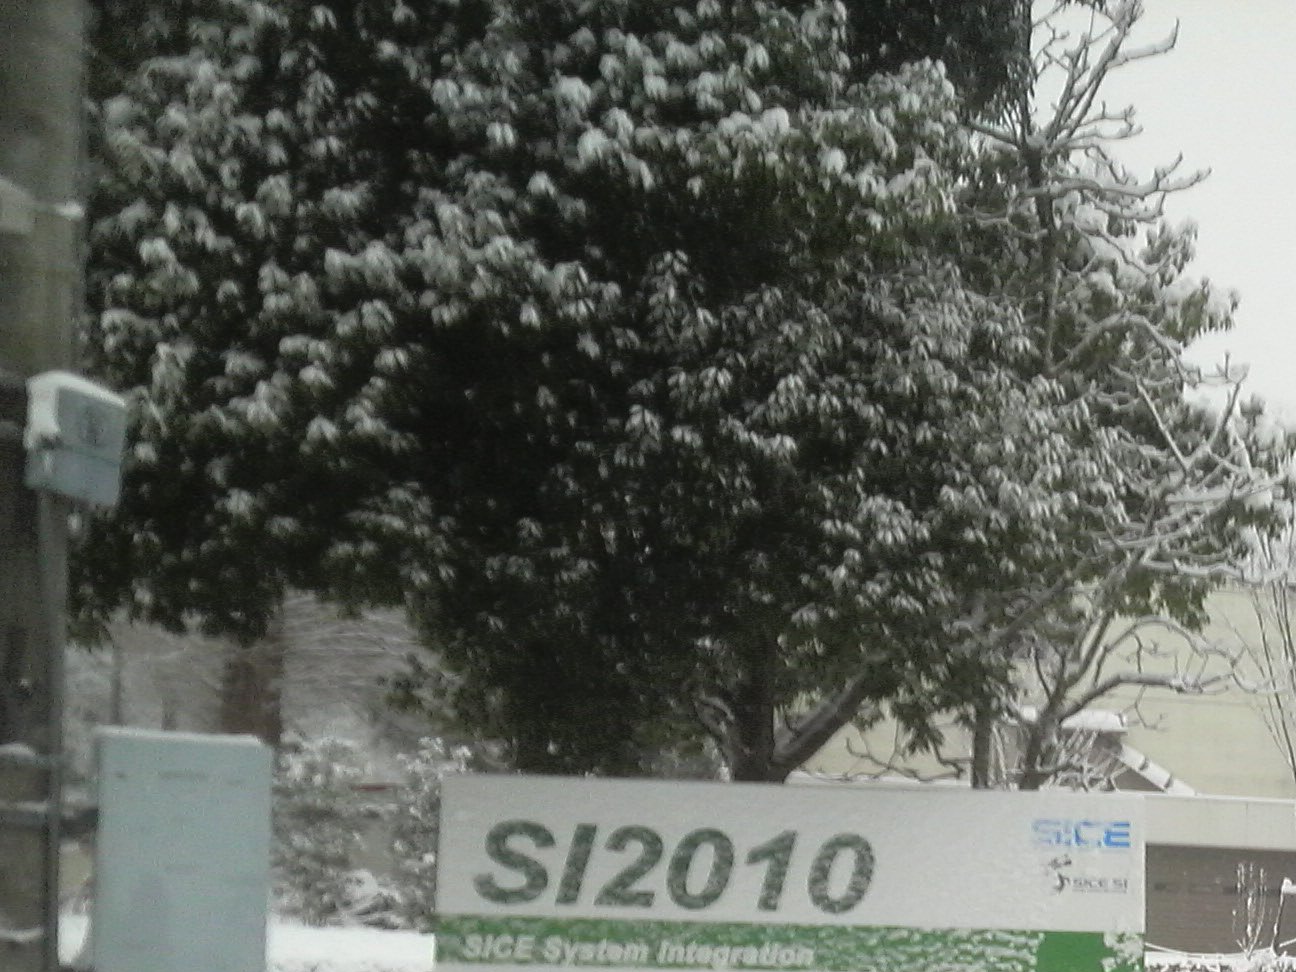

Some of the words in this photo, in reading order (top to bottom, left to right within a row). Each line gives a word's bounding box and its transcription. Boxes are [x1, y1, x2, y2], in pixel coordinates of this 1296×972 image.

[473, 819, 875, 914] SI2010
[464, 934, 535, 961] SICE
[543, 936, 650, 966] System
[655, 940, 815, 970] Integration
